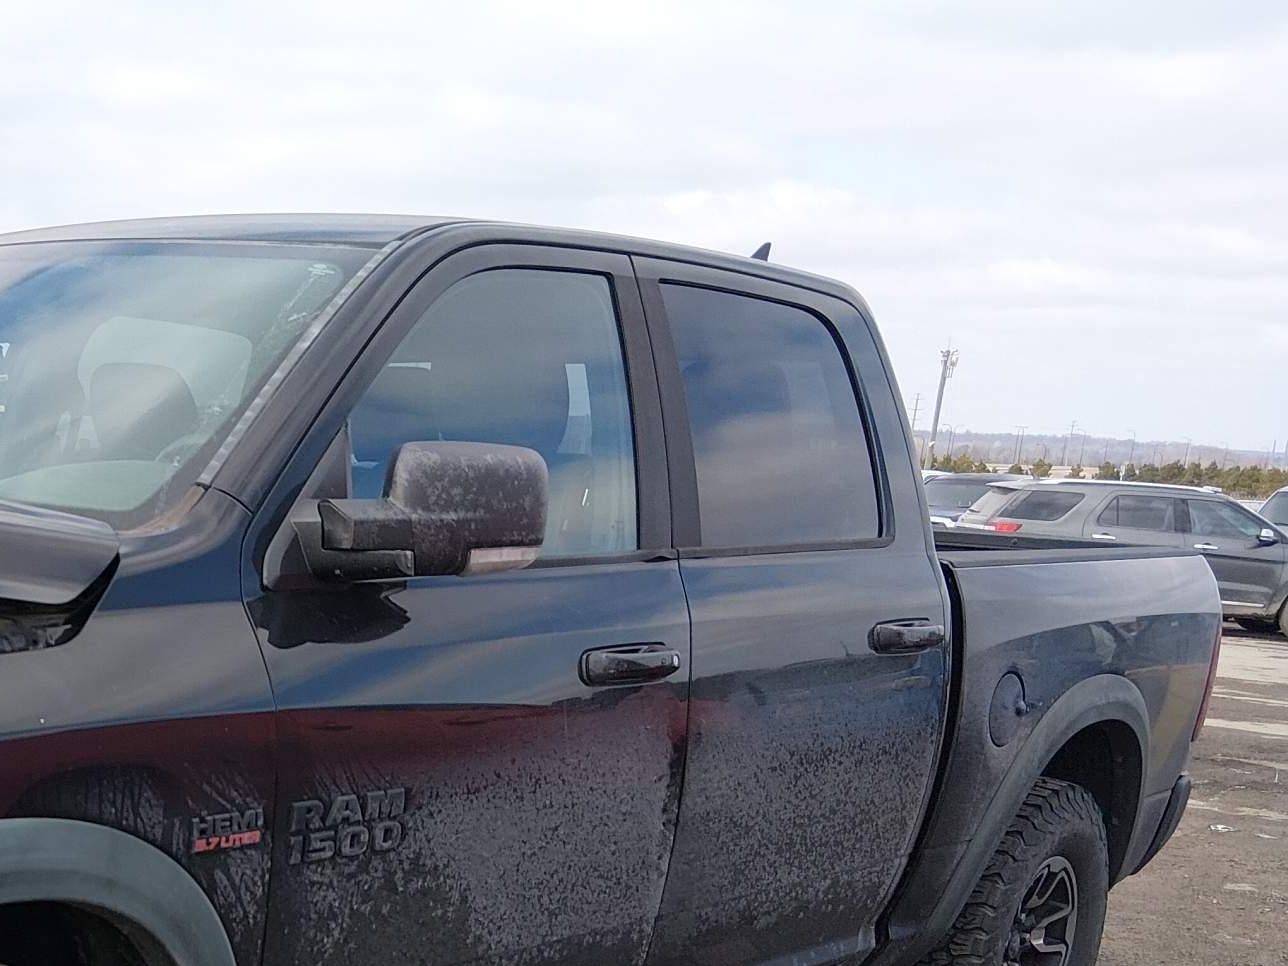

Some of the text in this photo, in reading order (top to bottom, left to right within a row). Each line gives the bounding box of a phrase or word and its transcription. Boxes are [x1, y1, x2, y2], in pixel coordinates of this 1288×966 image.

[192, 808, 264, 839] HEMI
[292, 787, 405, 832] RAM
[290, 820, 402, 864] 1500
